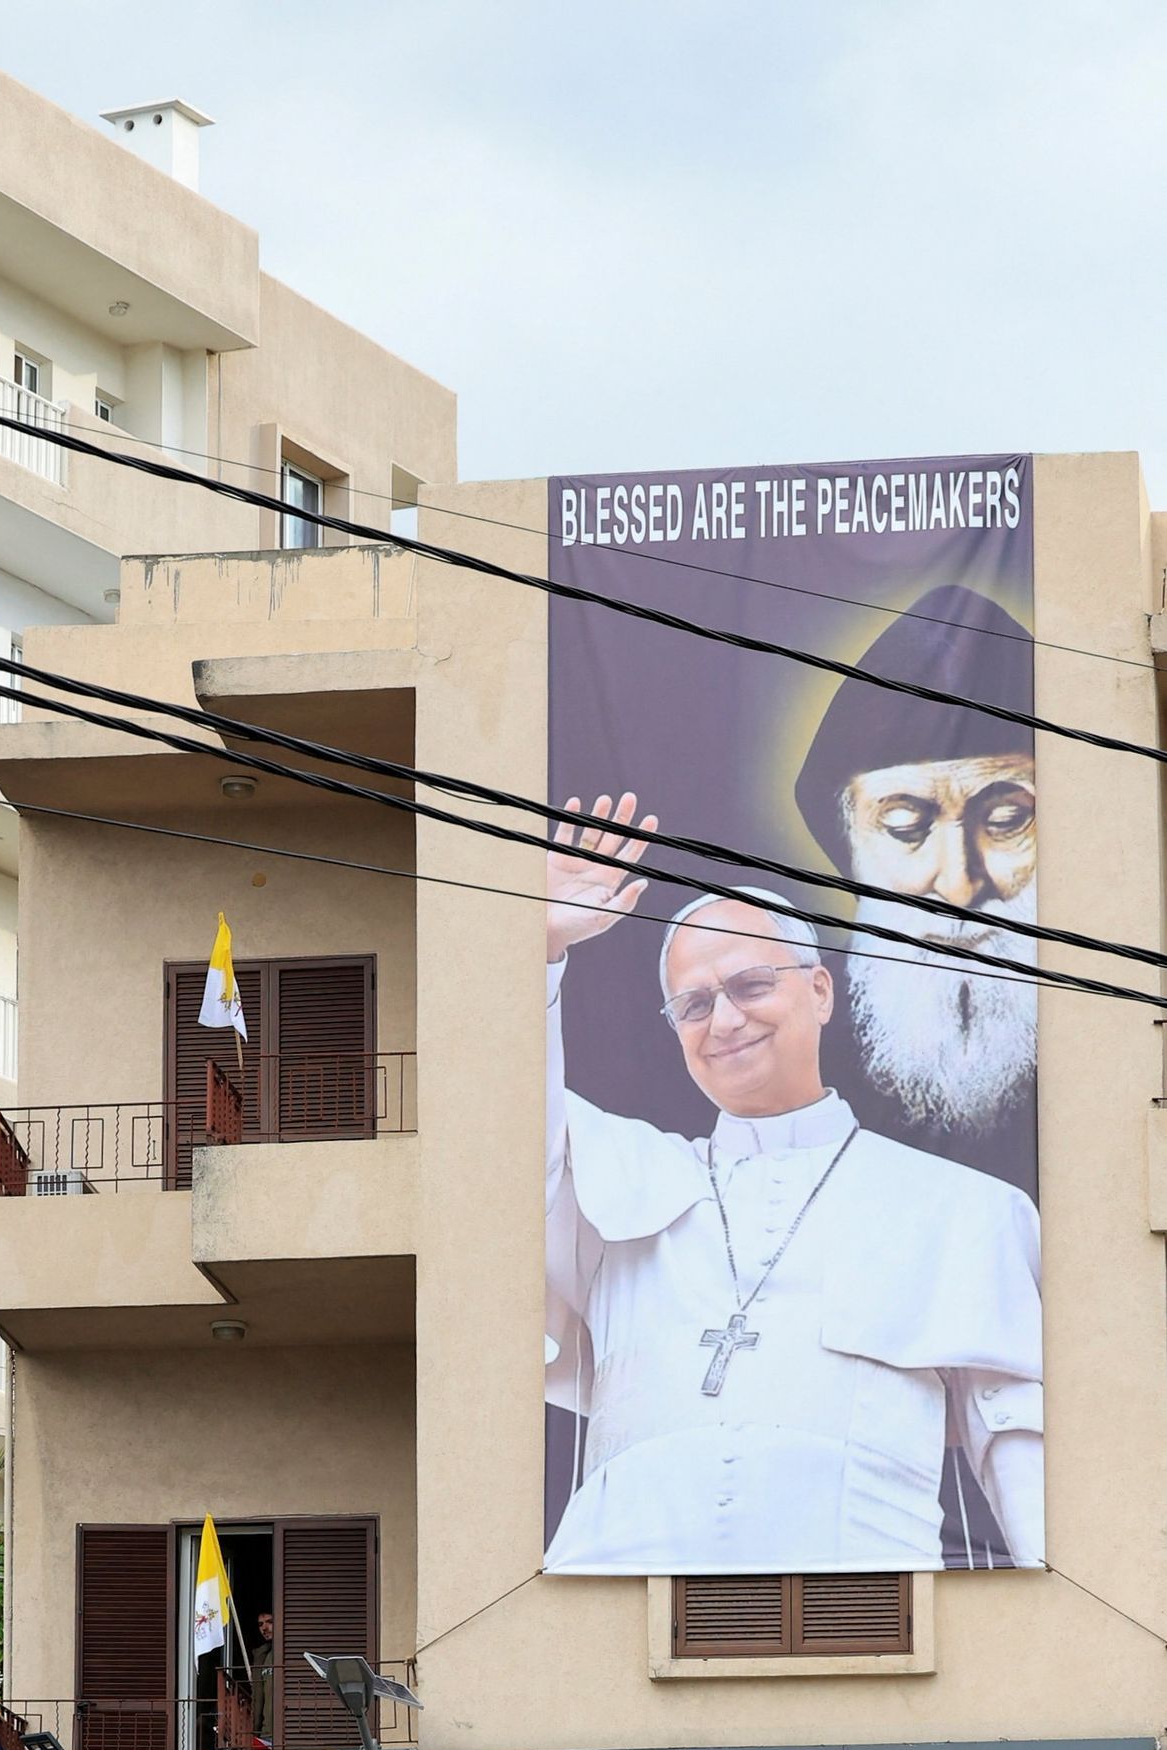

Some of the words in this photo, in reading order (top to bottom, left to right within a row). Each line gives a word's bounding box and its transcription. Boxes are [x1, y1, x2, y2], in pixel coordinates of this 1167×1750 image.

[561, 484, 683, 547] BLESSED
[691, 481, 746, 540] ARE
[755, 478, 807, 537] THE
[817, 467, 1021, 535] PEACEMAKERS
